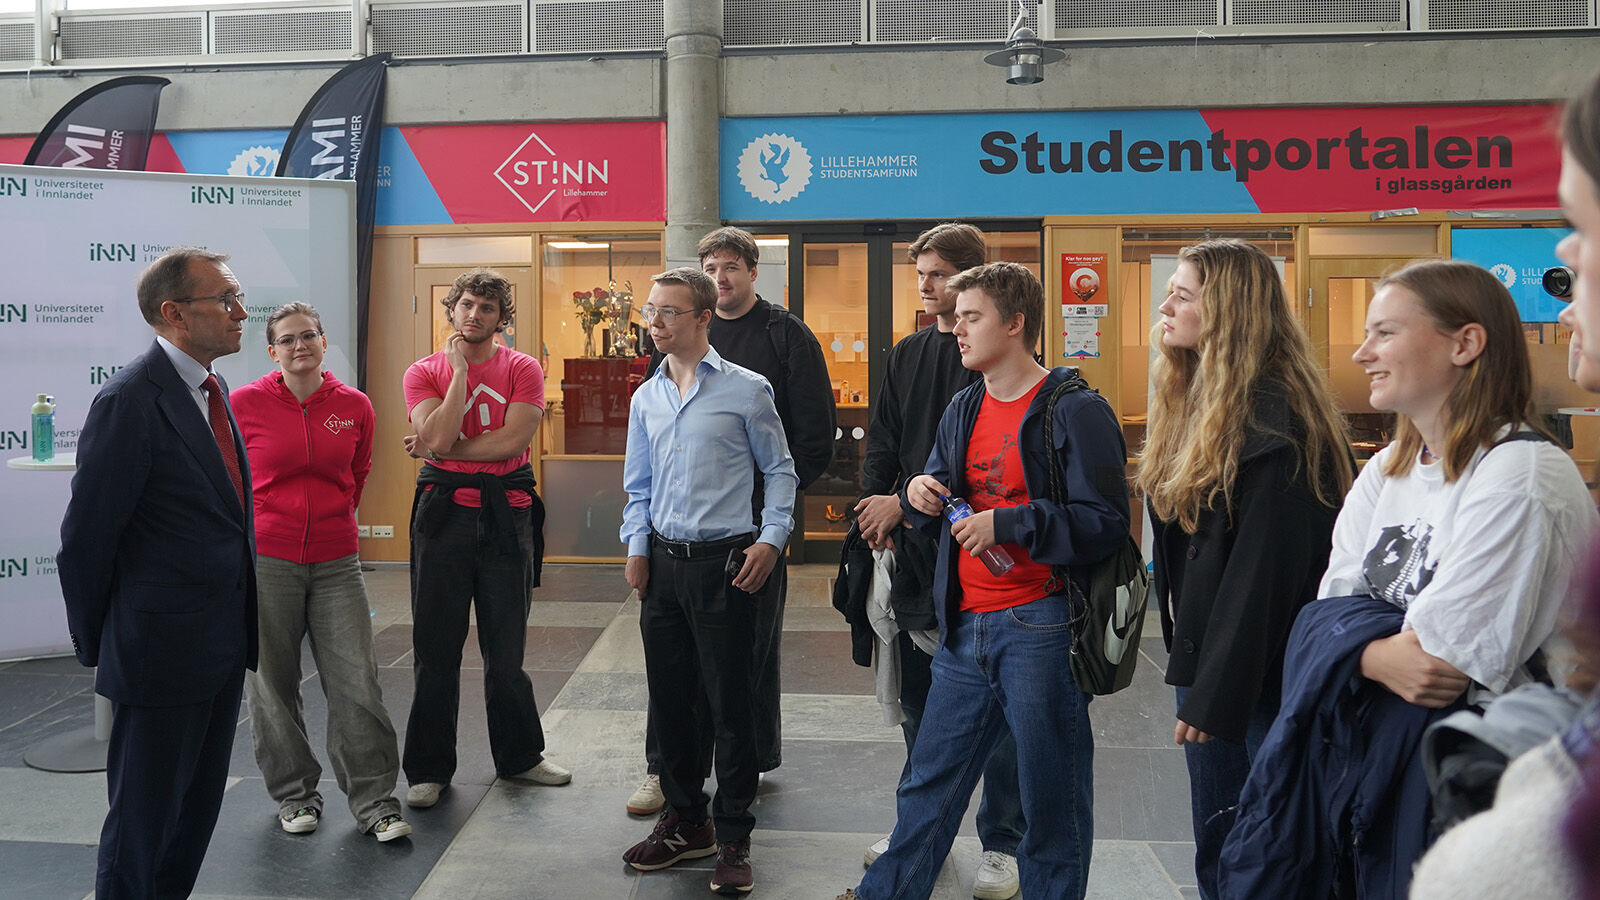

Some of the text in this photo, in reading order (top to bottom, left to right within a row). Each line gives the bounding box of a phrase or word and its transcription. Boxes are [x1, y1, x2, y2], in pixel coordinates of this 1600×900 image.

[979, 124, 1513, 183] Studentportalen
[821, 155, 918, 168] LILLEHAMMER
[820, 168, 918, 179] STUDENTSAMFUNN
[34, 178, 104, 190] Universitetet
[1376, 174, 1512, 194] i glassgården
[42, 190, 94, 200] Innlandet
[240, 187, 301, 197] Universitetet
[562, 188, 608, 197] Lillehammer
[247, 197, 293, 207] Innlandet
[34, 303, 104, 313] Universitetet
[42, 314, 94, 323] Innlandet
